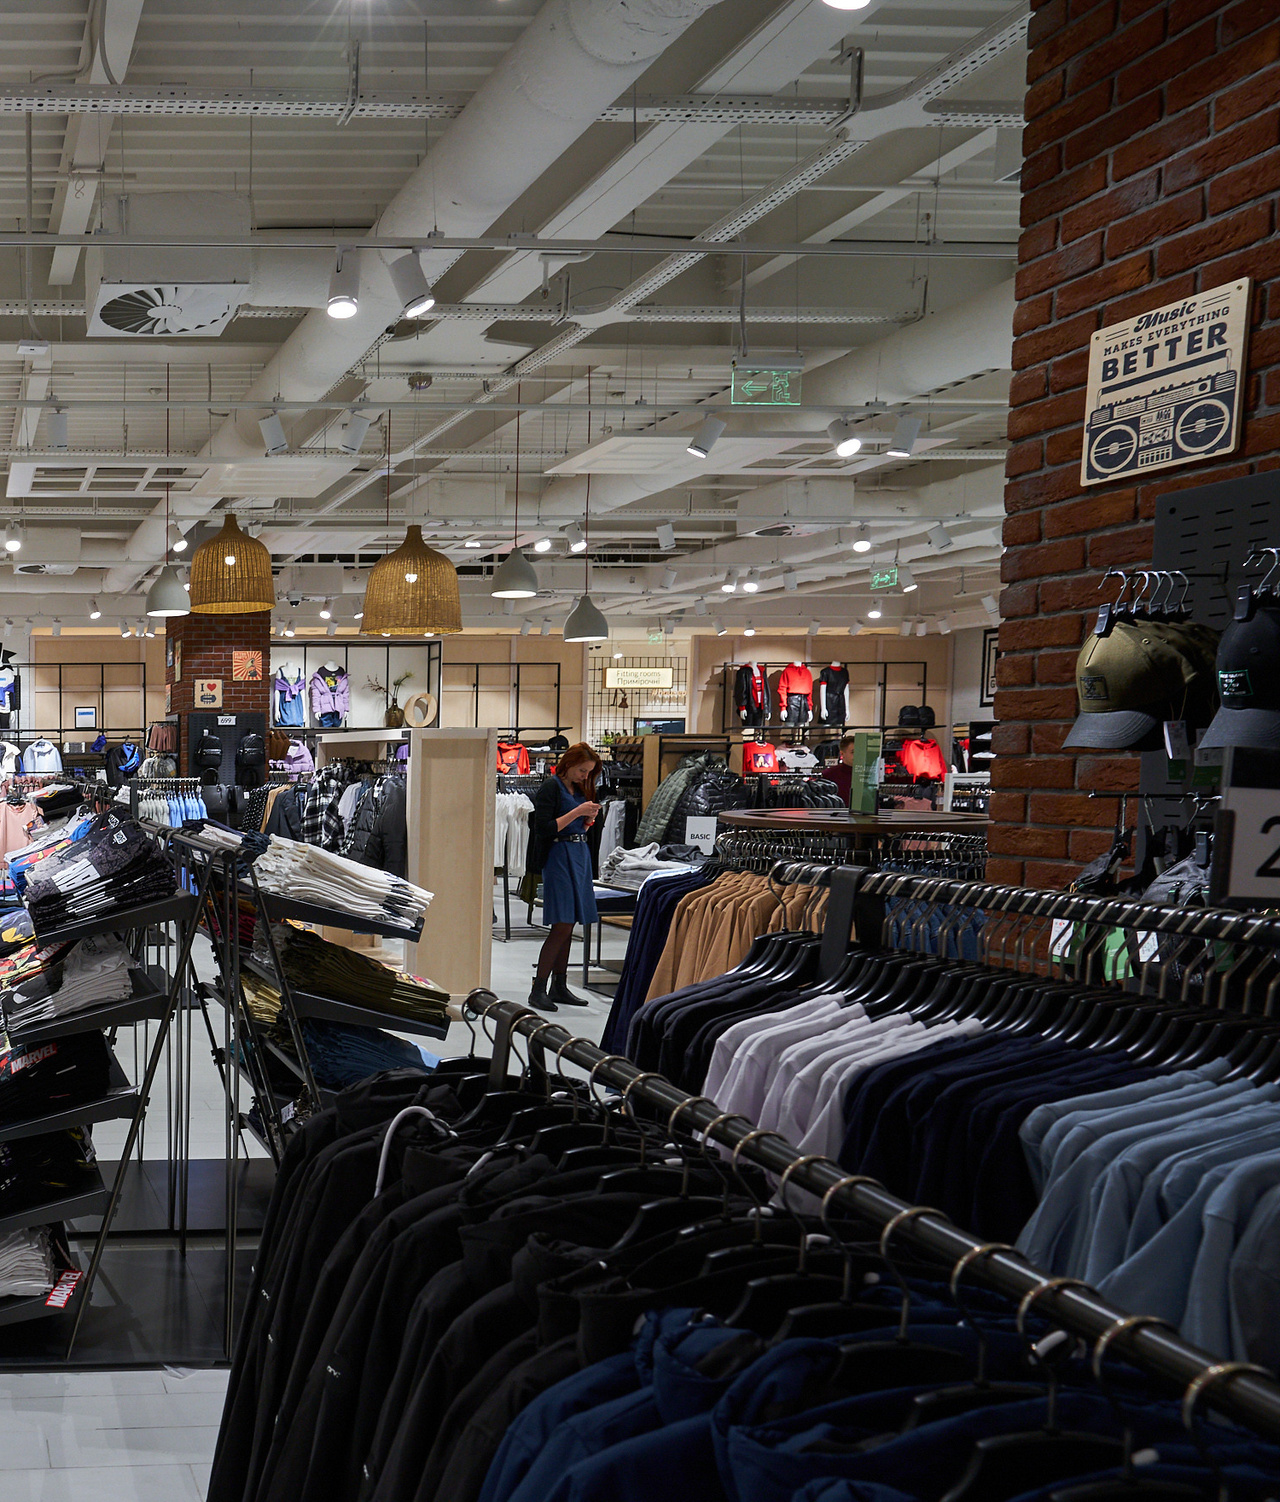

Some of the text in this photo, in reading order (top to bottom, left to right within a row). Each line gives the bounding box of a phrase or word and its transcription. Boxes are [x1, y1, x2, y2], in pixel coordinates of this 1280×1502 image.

[1103, 306, 1230, 357] MAKES EVERYTHING
[1133, 301, 1197, 333] Music
[1101, 322, 1228, 383] BETTER
[616, 670, 639, 678] Fitting
[617, 677, 661, 686] Примірочні
[1254, 815, 1280, 878] 2
[11, 1045, 56, 1073] MARVEL
